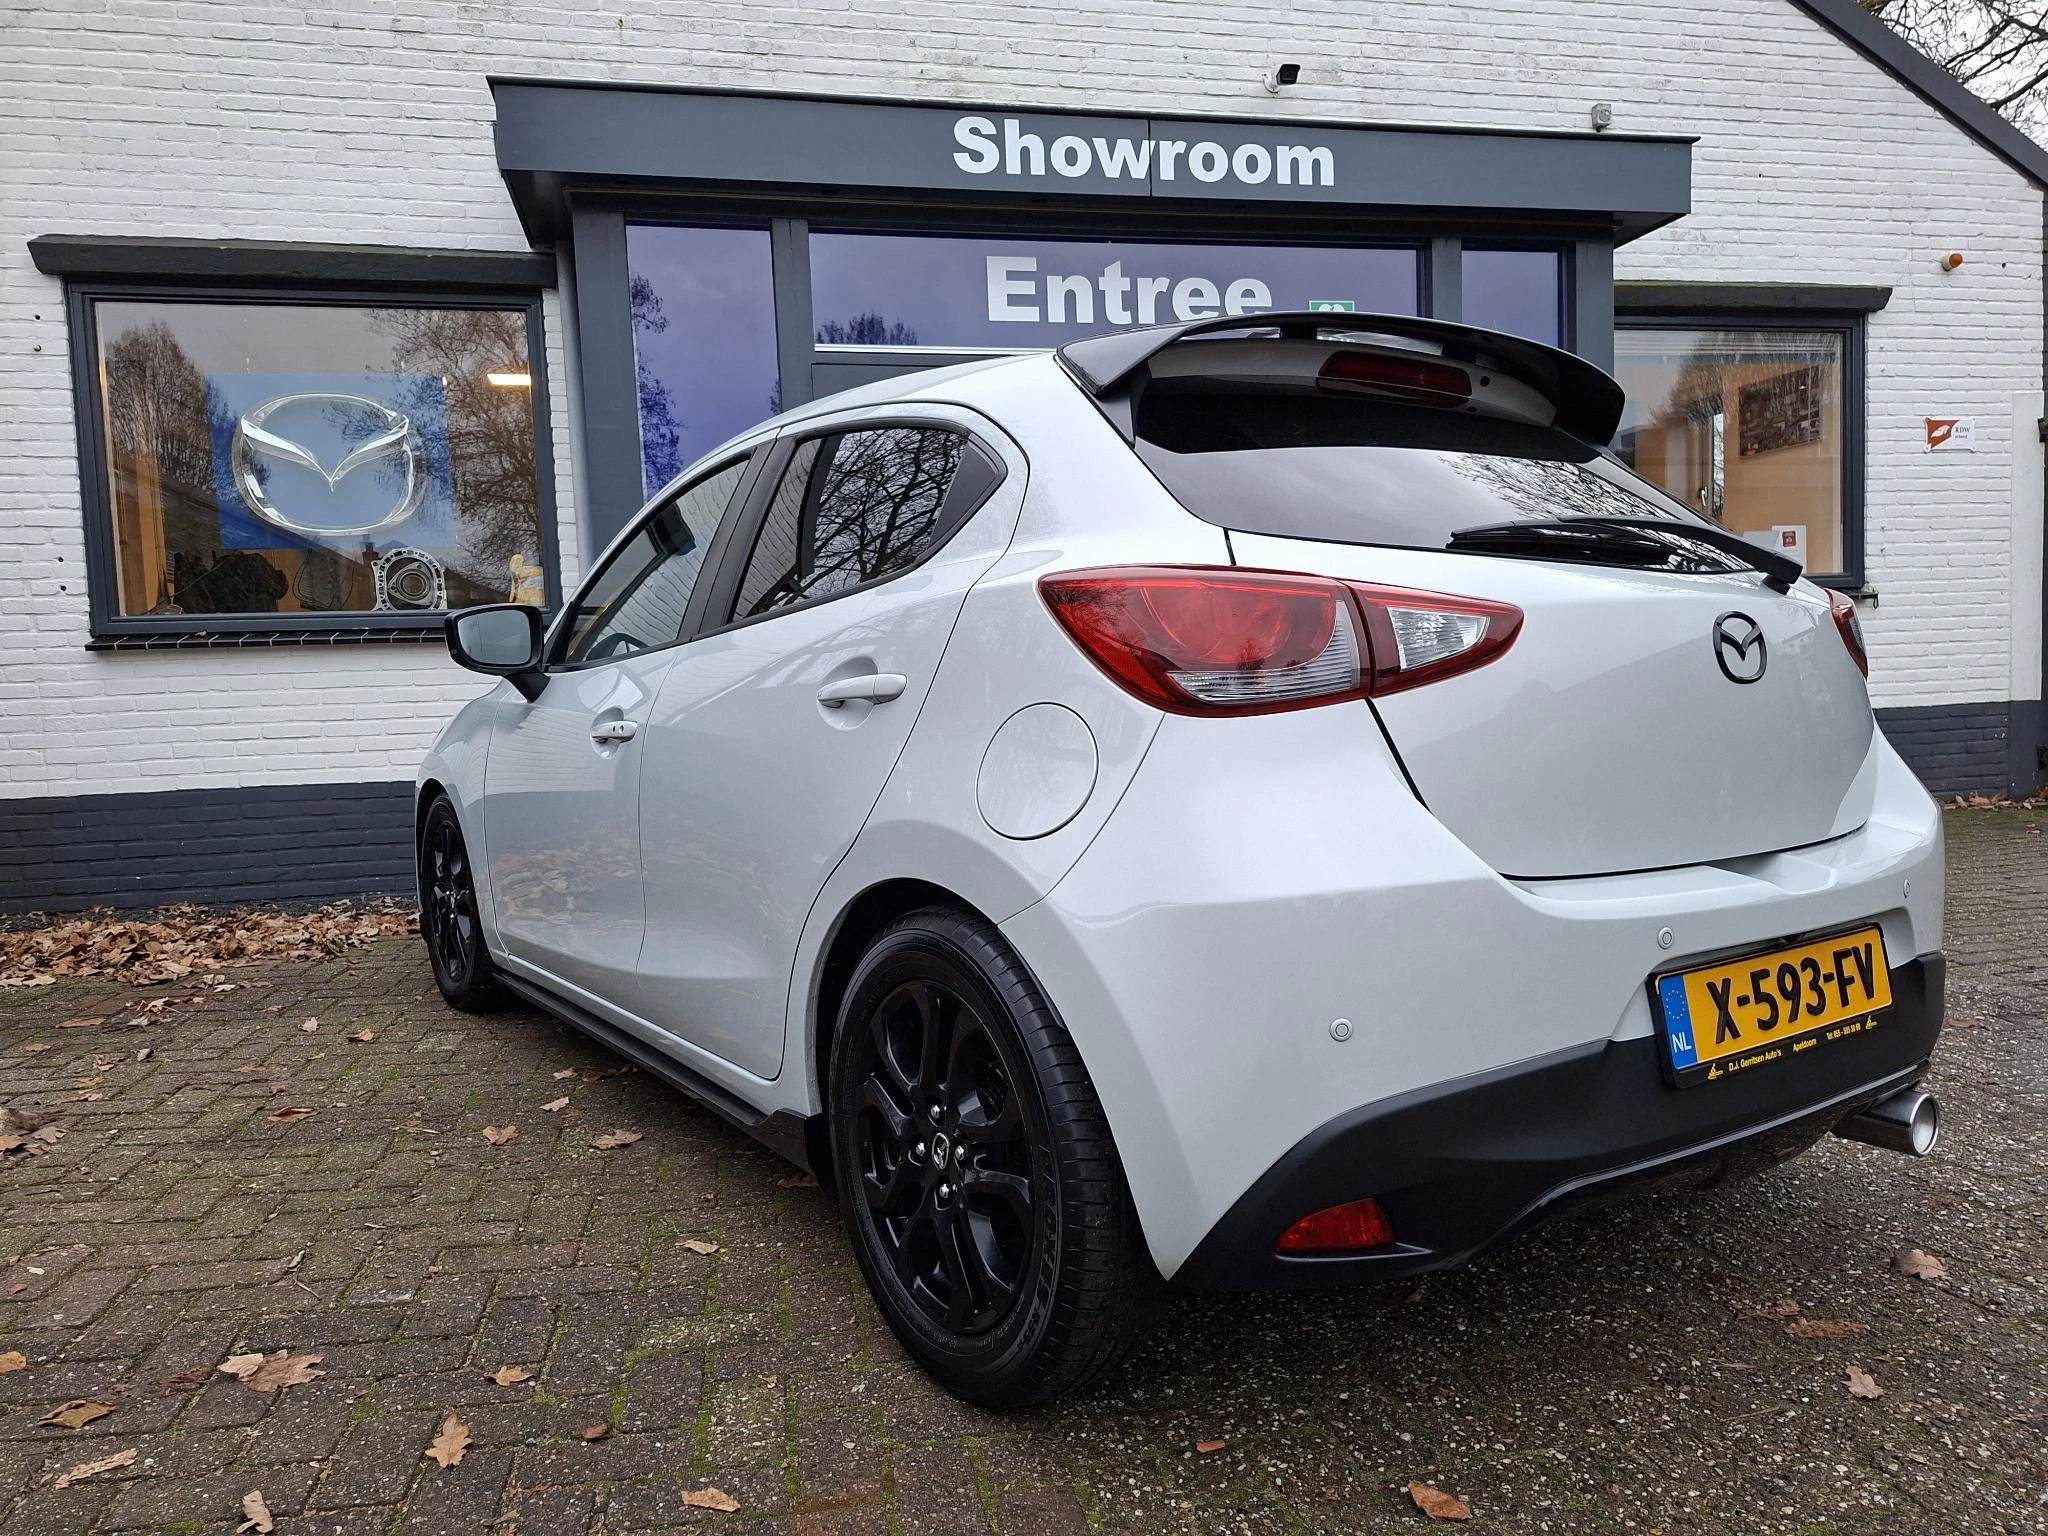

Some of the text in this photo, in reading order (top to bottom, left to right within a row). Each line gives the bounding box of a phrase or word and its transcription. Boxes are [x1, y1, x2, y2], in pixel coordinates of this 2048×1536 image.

[953, 116, 1335, 186] Showroom
[986, 255, 1273, 325] Entree
[1706, 943, 1874, 1044] X-593-FV
[1672, 1032, 1692, 1053] NL
[1765, 1048, 1782, 1060] Auto's
